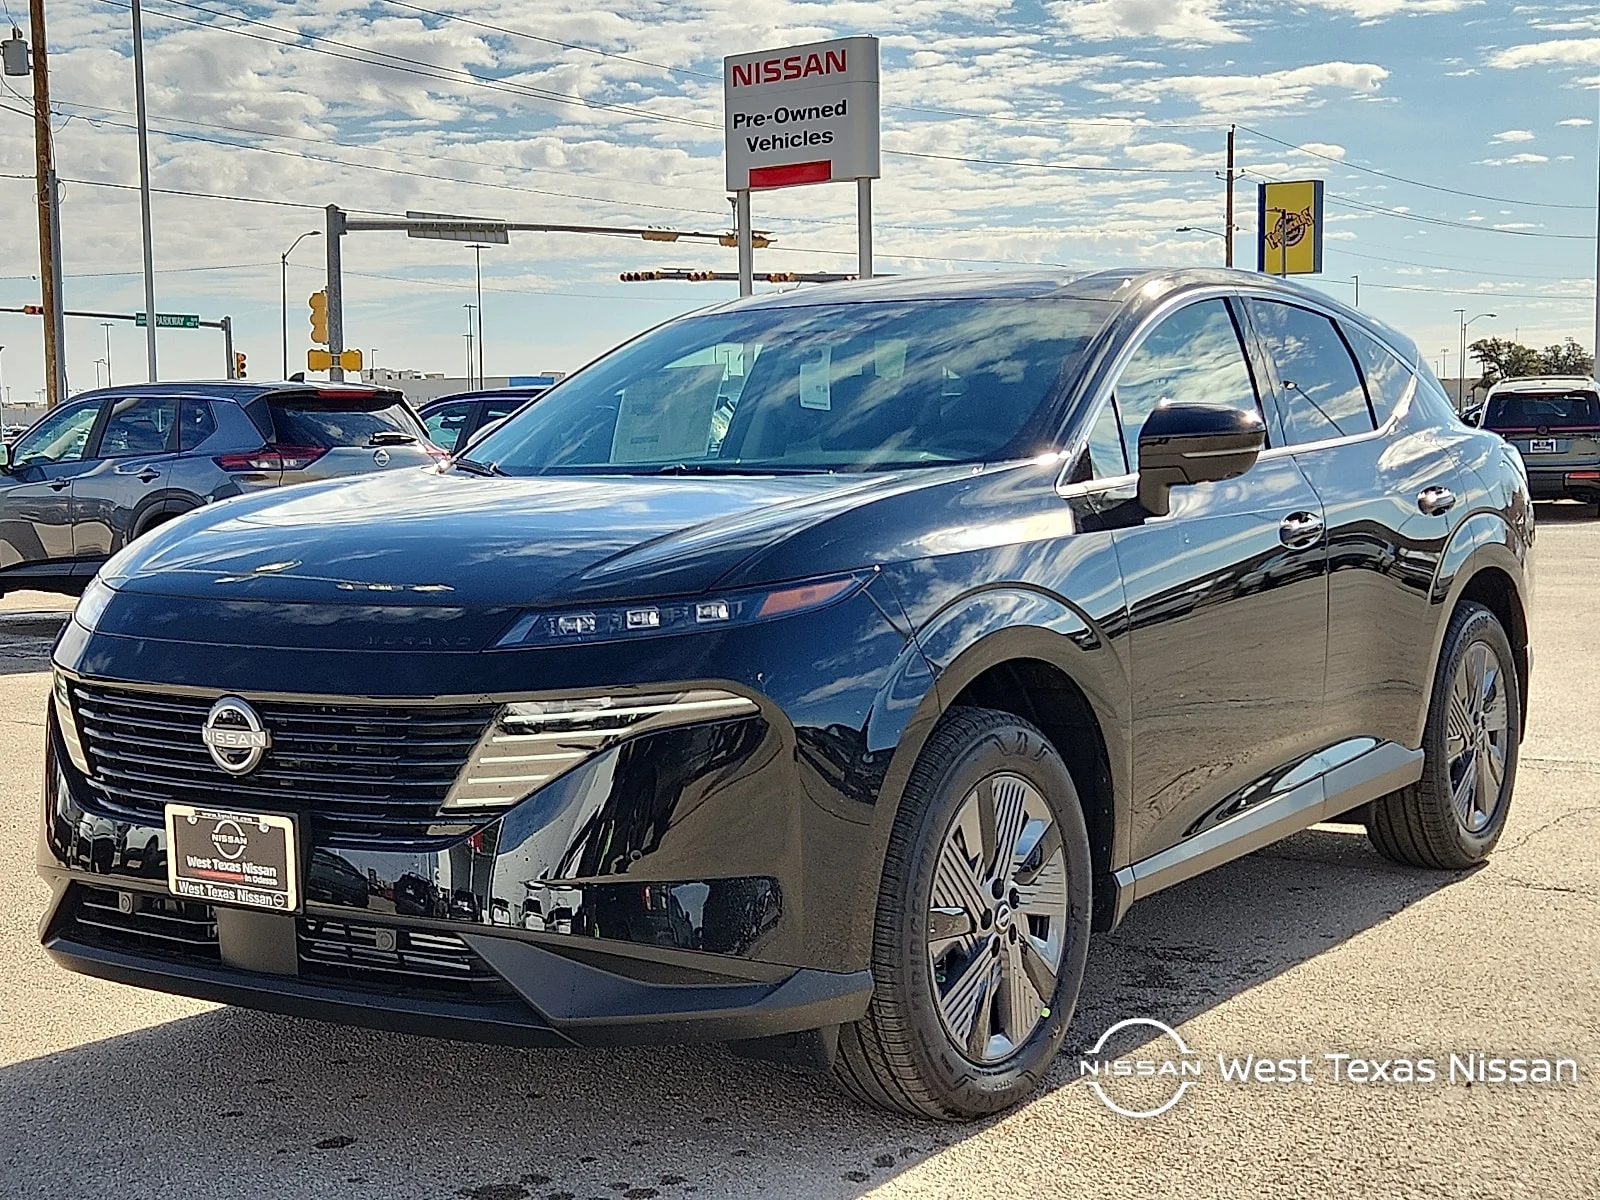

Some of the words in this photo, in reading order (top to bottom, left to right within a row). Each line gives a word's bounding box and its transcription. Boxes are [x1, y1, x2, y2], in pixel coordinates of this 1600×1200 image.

[732, 48, 847, 87] NISSAN
[733, 99, 848, 129] Pre-Owned
[746, 130, 834, 153] Vehicles
[156, 315, 185, 326] PARKWAY
[203, 731, 264, 745] NISSAN
[211, 833, 248, 845] NISSAN
[186, 855, 211, 869] West
[212, 858, 241, 872] Texas
[242, 862, 276, 877] Nissan
[252, 875, 278, 886] Odessa
[178, 880, 205, 895] West
[205, 884, 235, 899] Texas
[237, 889, 272, 905] Nissan
